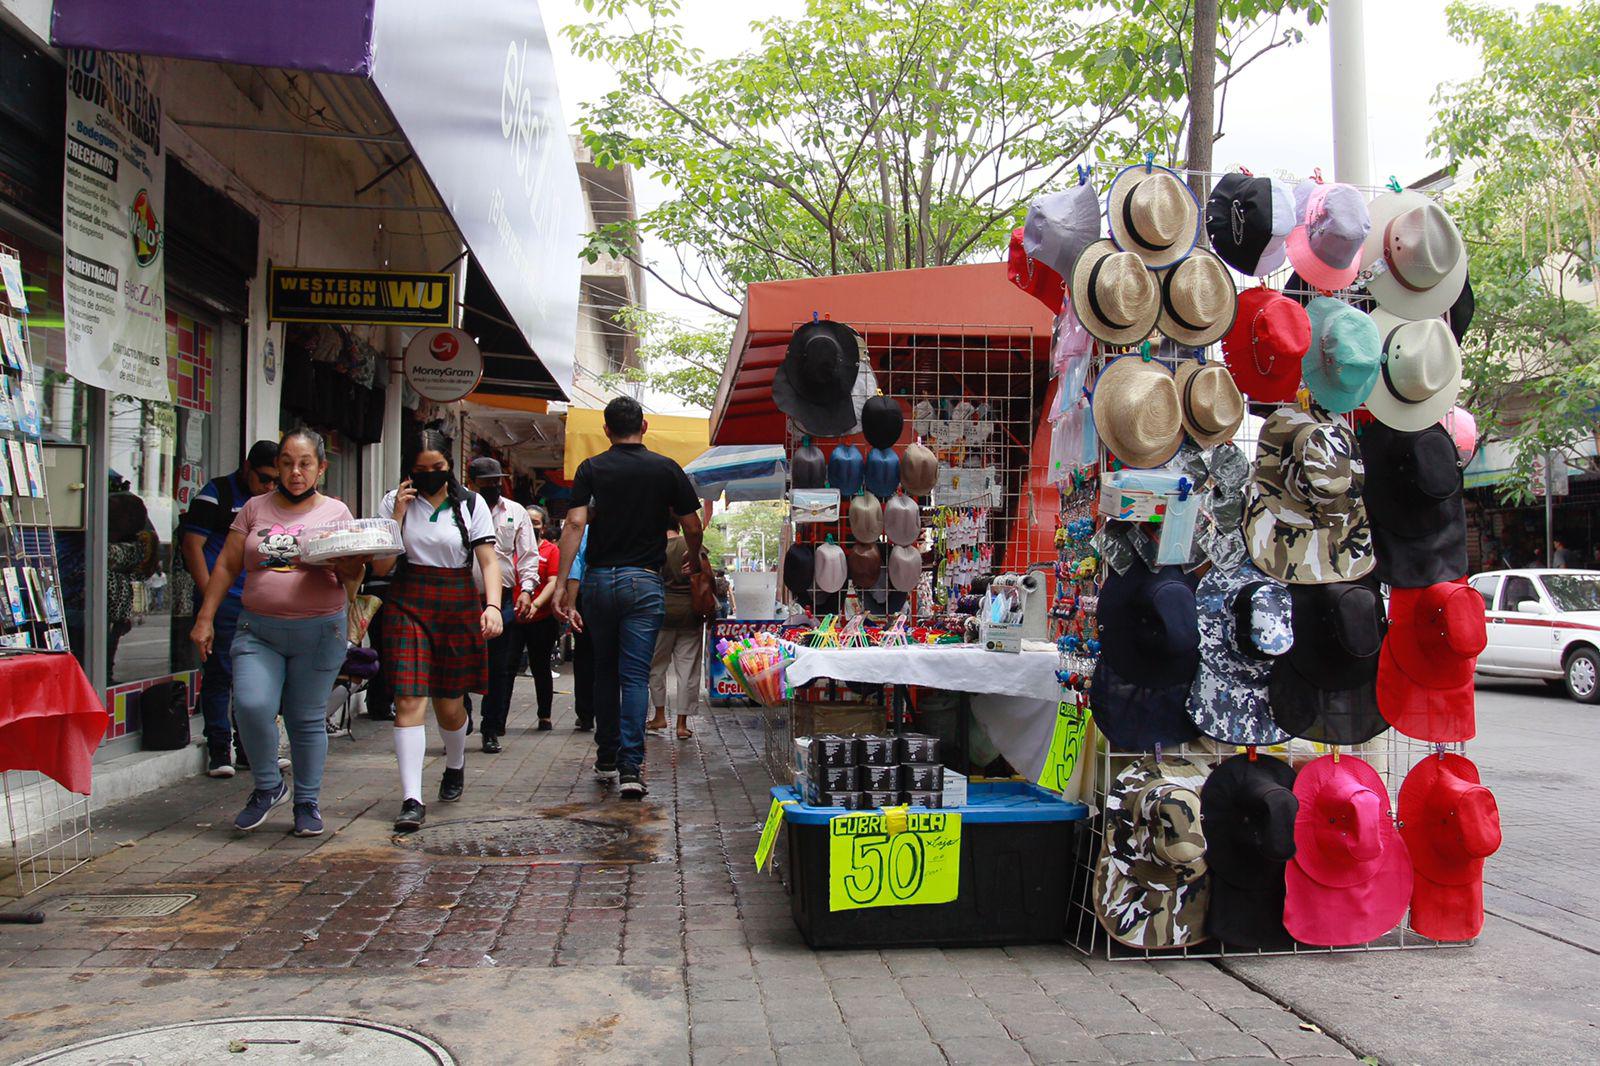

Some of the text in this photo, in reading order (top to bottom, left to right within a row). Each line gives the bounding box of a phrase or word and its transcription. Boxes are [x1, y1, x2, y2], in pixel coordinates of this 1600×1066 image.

[280, 277, 443, 310] WESTERN WU
[310, 291, 376, 306] UNION
[412, 365, 474, 378] MoneyGram
[906, 813, 947, 833] OCA
[844, 832, 926, 905] 50
